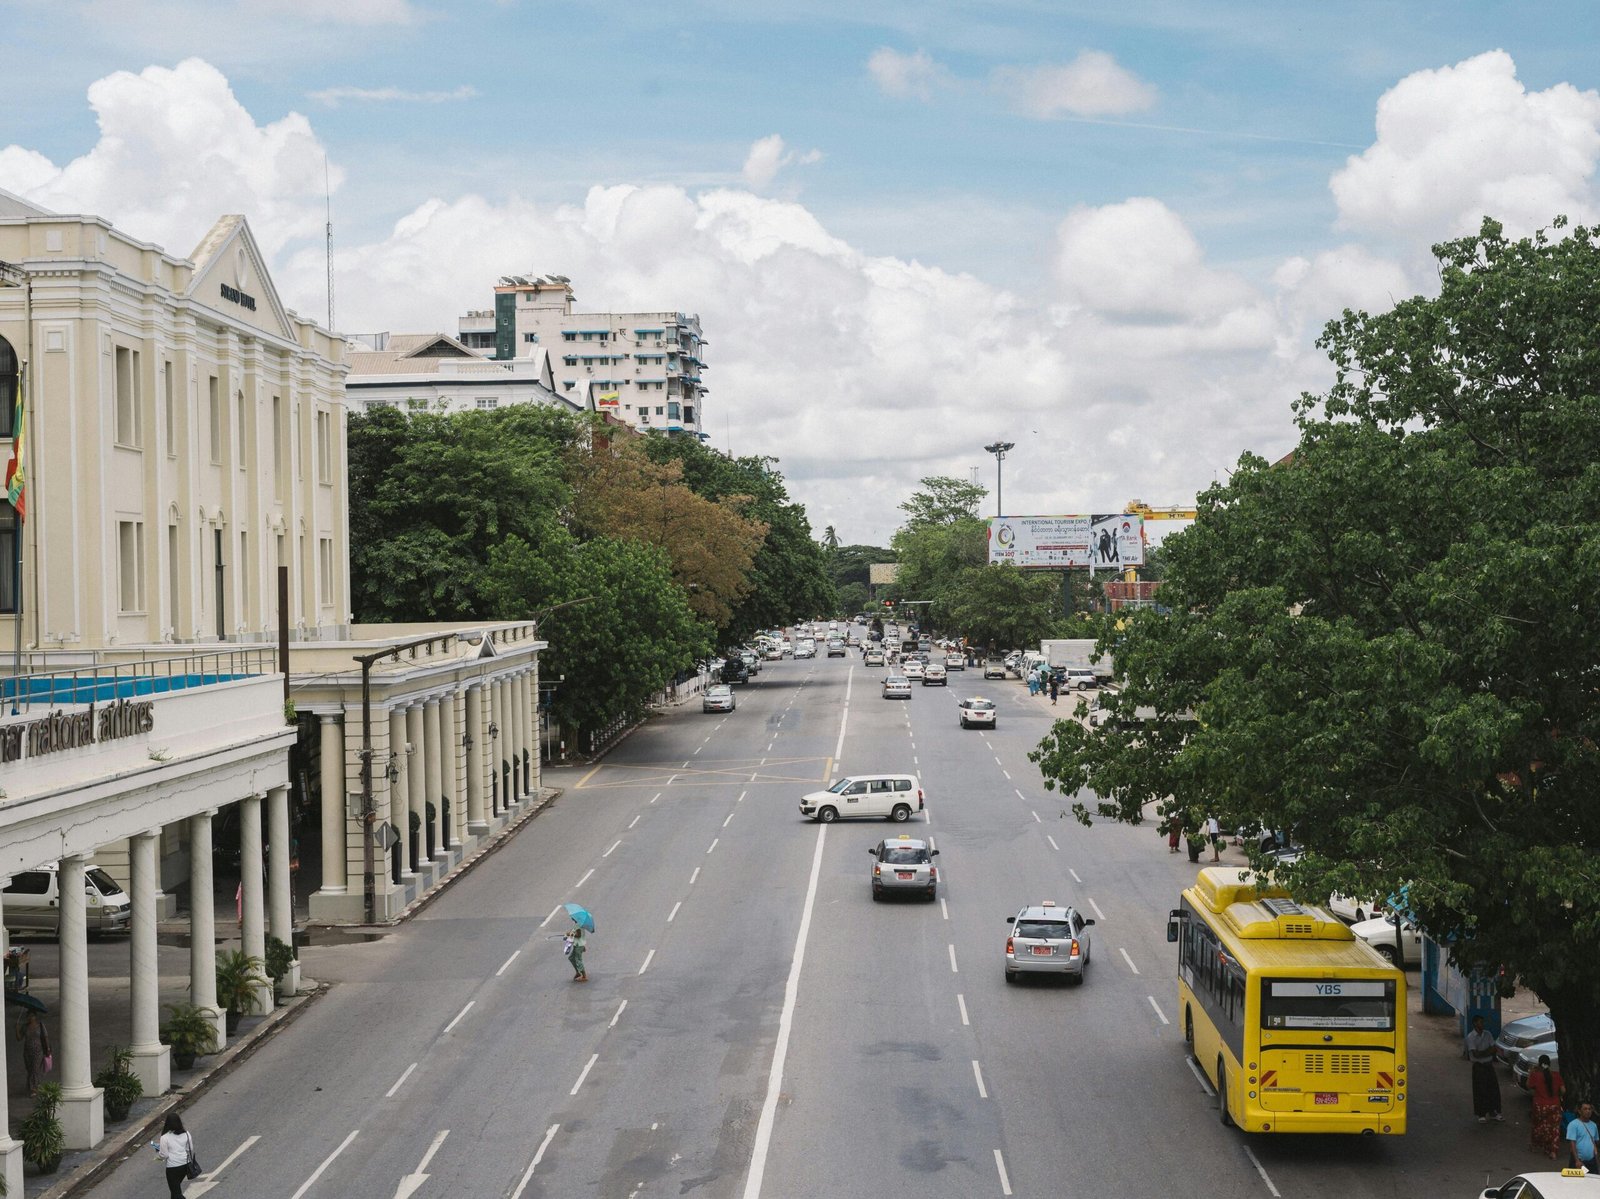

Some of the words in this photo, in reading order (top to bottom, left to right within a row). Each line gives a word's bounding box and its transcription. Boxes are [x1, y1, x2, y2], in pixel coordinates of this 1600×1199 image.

[25, 703, 96, 757] national
[98, 698, 154, 741] airlines
[1316, 984, 1341, 995] YBS
